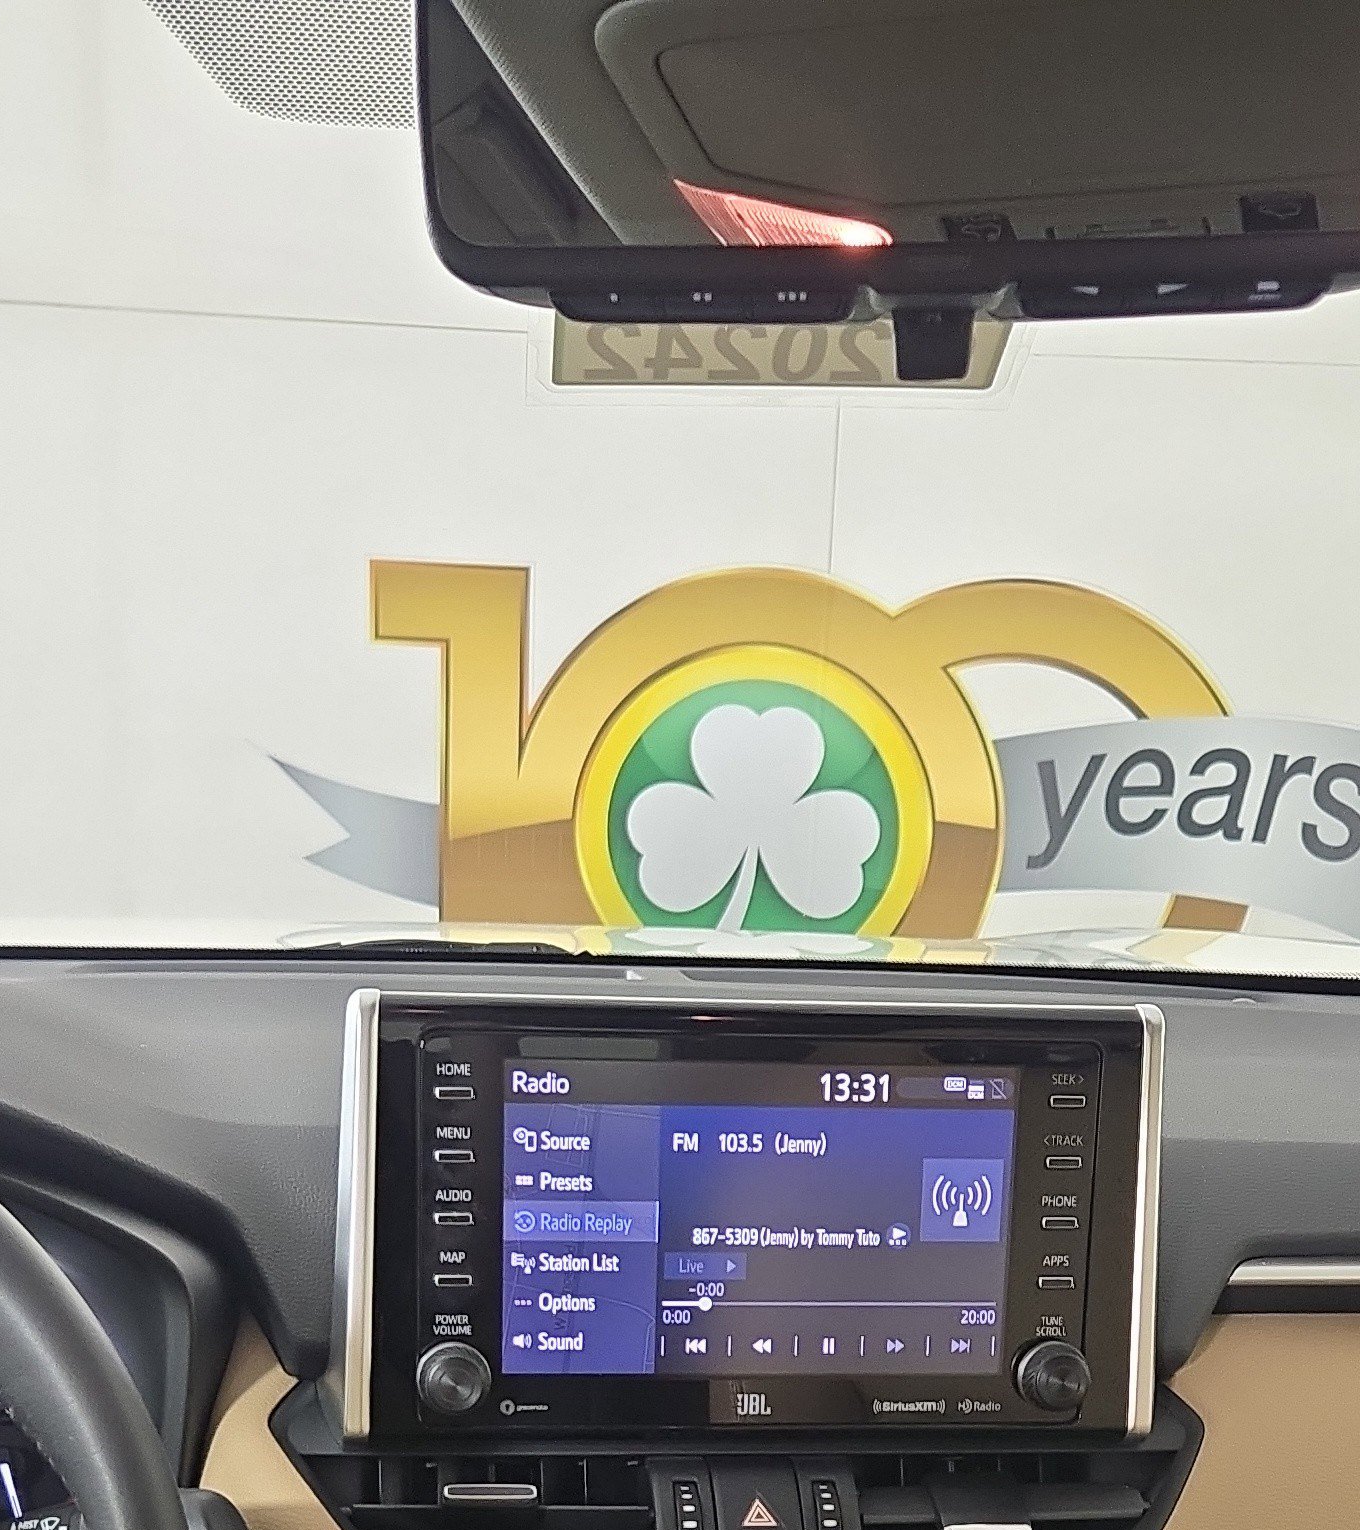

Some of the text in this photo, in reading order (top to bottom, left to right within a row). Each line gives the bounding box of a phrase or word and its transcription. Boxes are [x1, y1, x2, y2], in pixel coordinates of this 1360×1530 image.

[436, 1062, 472, 1076] HOME
[511, 1070, 890, 1103] Radio 13:31
[436, 1126, 471, 1139] MENU
[540, 1131, 591, 1151] Source
[672, 1131, 828, 1157] FM 103.5 (Jenny)
[539, 1171, 593, 1192] Presets
[435, 1189, 473, 1202] AUDIO
[1041, 1195, 1078, 1208] PHONE
[540, 1212, 634, 1236] Radio Replay
[692, 1226, 881, 1250] 867-5309 (Jenny) by Tommy Tuto
[439, 1250, 467, 1264] MAP
[538, 1252, 620, 1273] Station List
[1042, 1255, 1071, 1268] APPS
[679, 1258, 705, 1274] Live
[688, 1282, 725, 1297] -0:00
[538, 1292, 596, 1316] Options
[434, 1314, 470, 1325] POWER
[662, 1309, 691, 1324] 0:00
[960, 1309, 997, 1325] 20:00
[1040, 1316, 1064, 1326] TUNE
[432, 1325, 473, 1336] VOLUME
[1035, 1326, 1067, 1337] SCROLL
[537, 1331, 584, 1352] Sound
[736, 1393, 772, 1415] JBL
[881, 1400, 938, 1413] SiriusXM
[973, 1400, 1002, 1412] Radio
